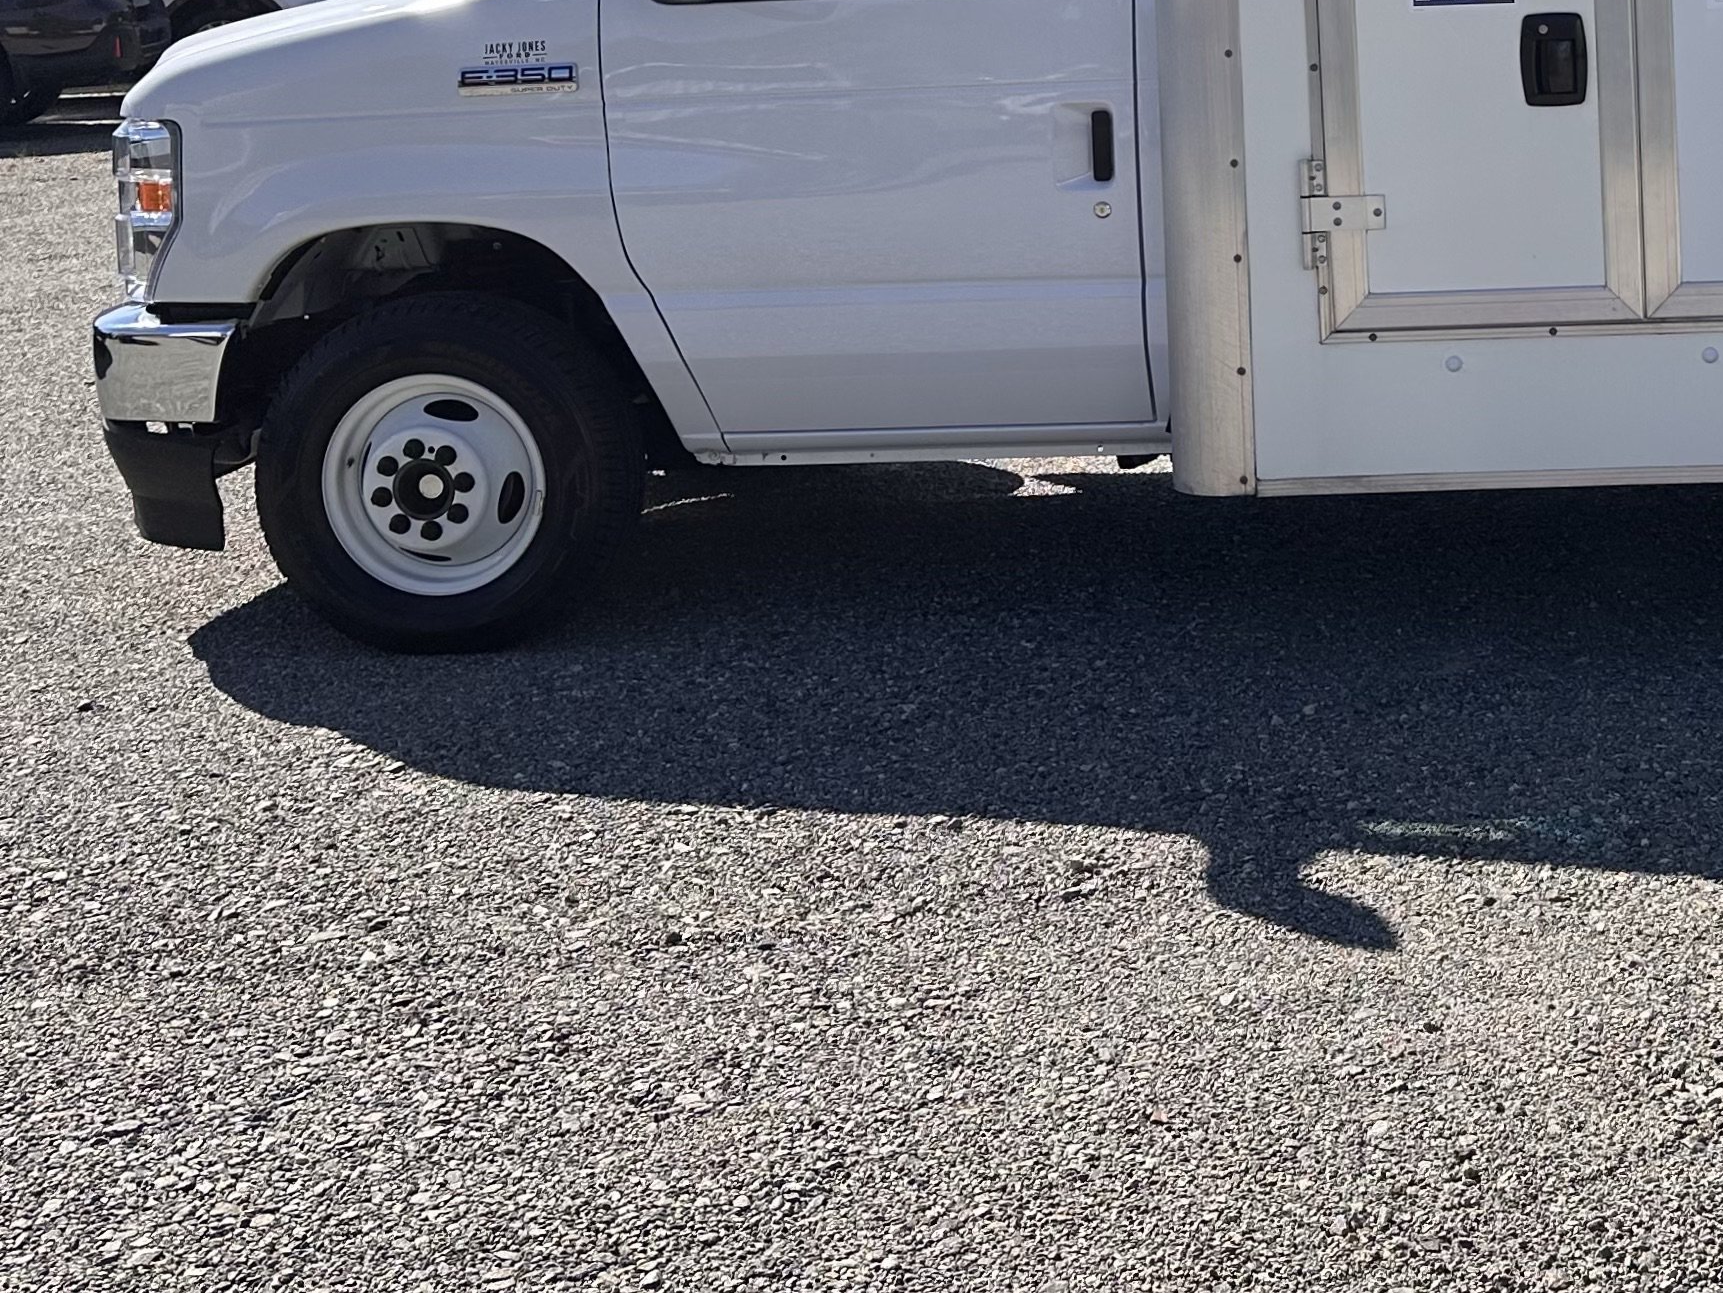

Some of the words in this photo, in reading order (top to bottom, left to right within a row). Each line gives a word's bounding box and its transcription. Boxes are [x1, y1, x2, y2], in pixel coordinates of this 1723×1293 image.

[484, 42, 513, 55] JACKY
[517, 40, 546, 53] JONES
[499, 51, 531, 59] FORD
[546, 84, 573, 92] DUTY
